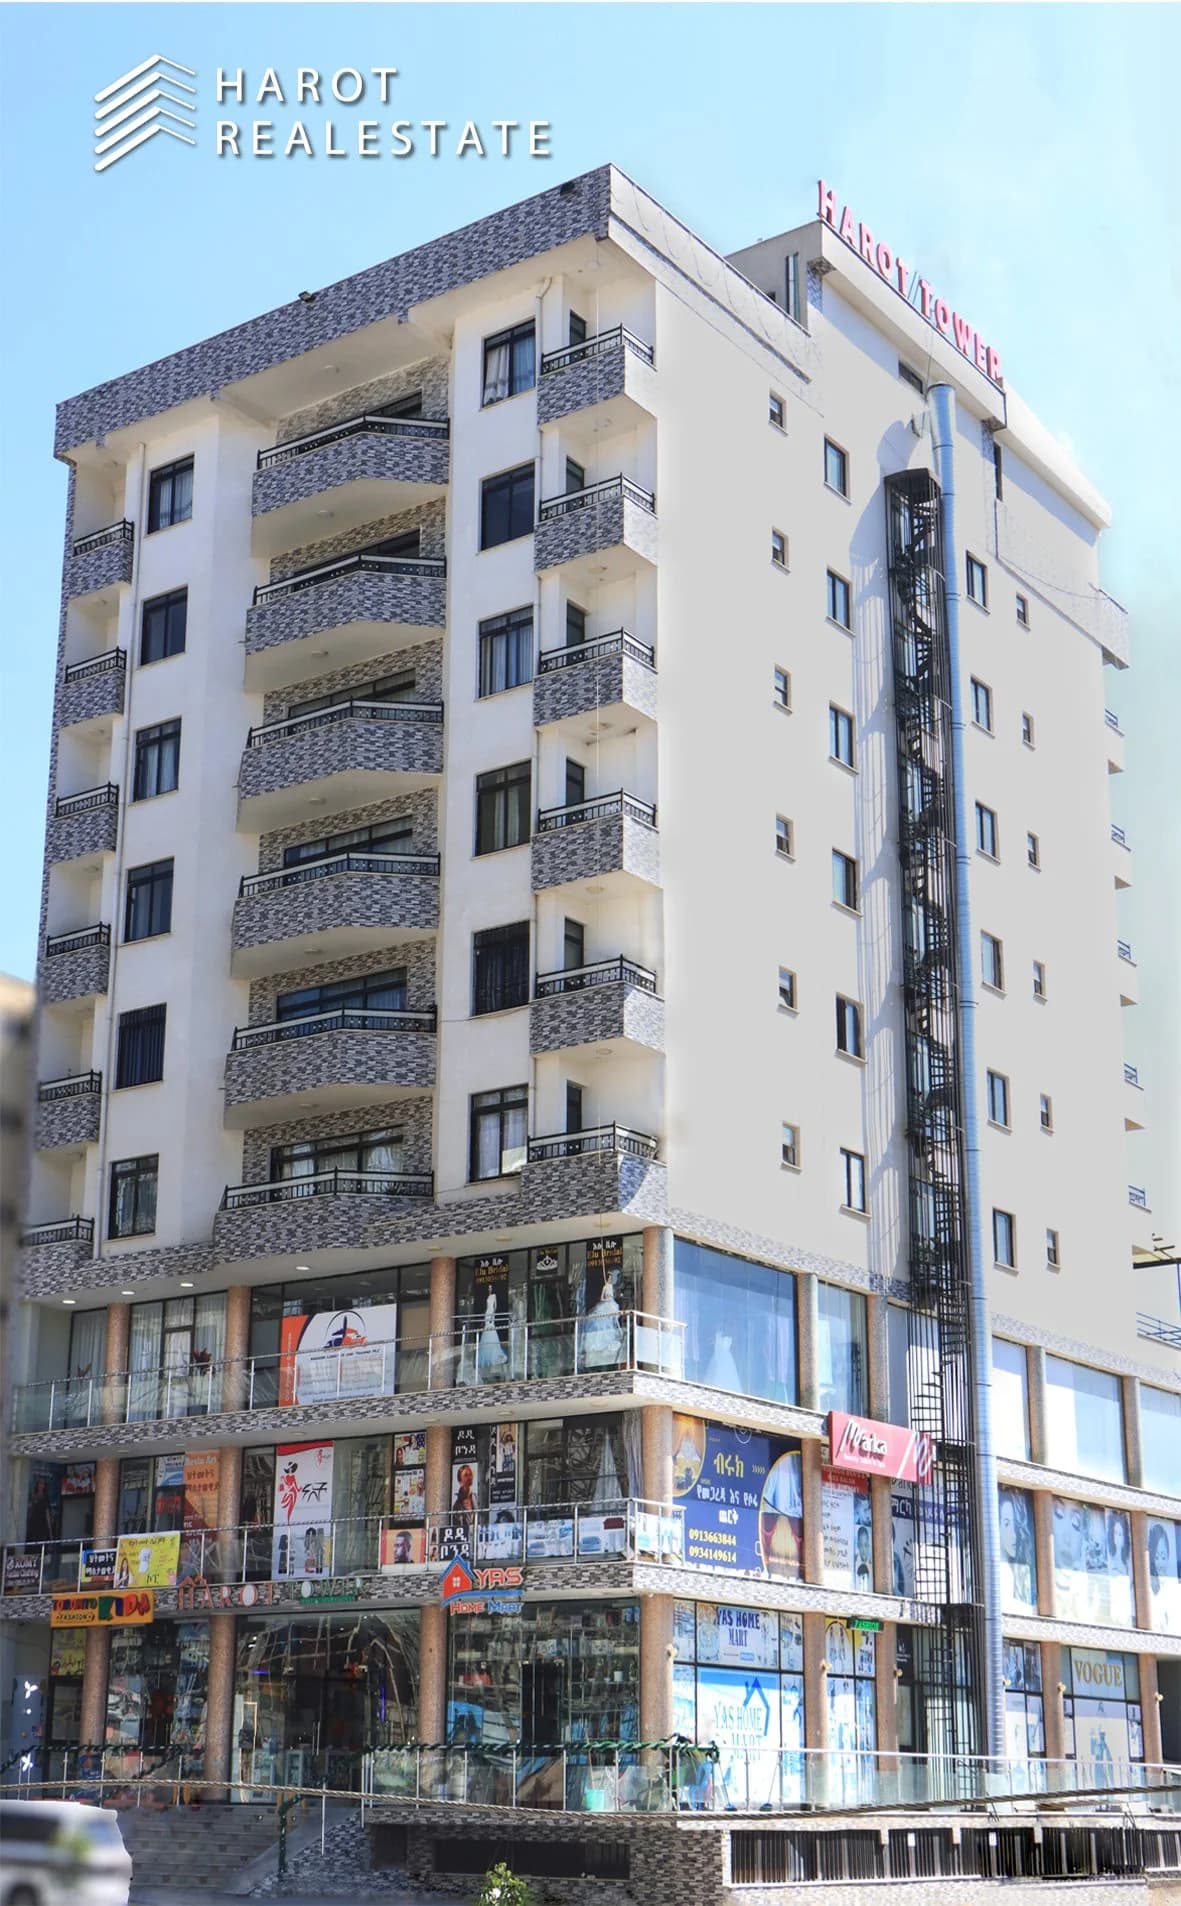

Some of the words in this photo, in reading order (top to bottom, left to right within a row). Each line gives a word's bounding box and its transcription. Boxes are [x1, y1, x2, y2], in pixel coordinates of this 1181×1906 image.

[817, 179, 909, 298] HAROT
[918, 278, 1003, 380] TOWER
[713, 1452, 744, 1479] ብሩክ
[473, 1566, 524, 1590] YAS
[178, 1575, 273, 1610] HAROT
[59, 1613, 88, 1621] FASHION
[715, 1607, 733, 1626] YAS
[736, 1611, 760, 1630] HOME
[728, 1628, 748, 1647] MART
[1074, 1659, 1122, 1688] VOGUE
[713, 1700, 734, 1730] YAS
[736, 1706, 763, 1731] HOME
